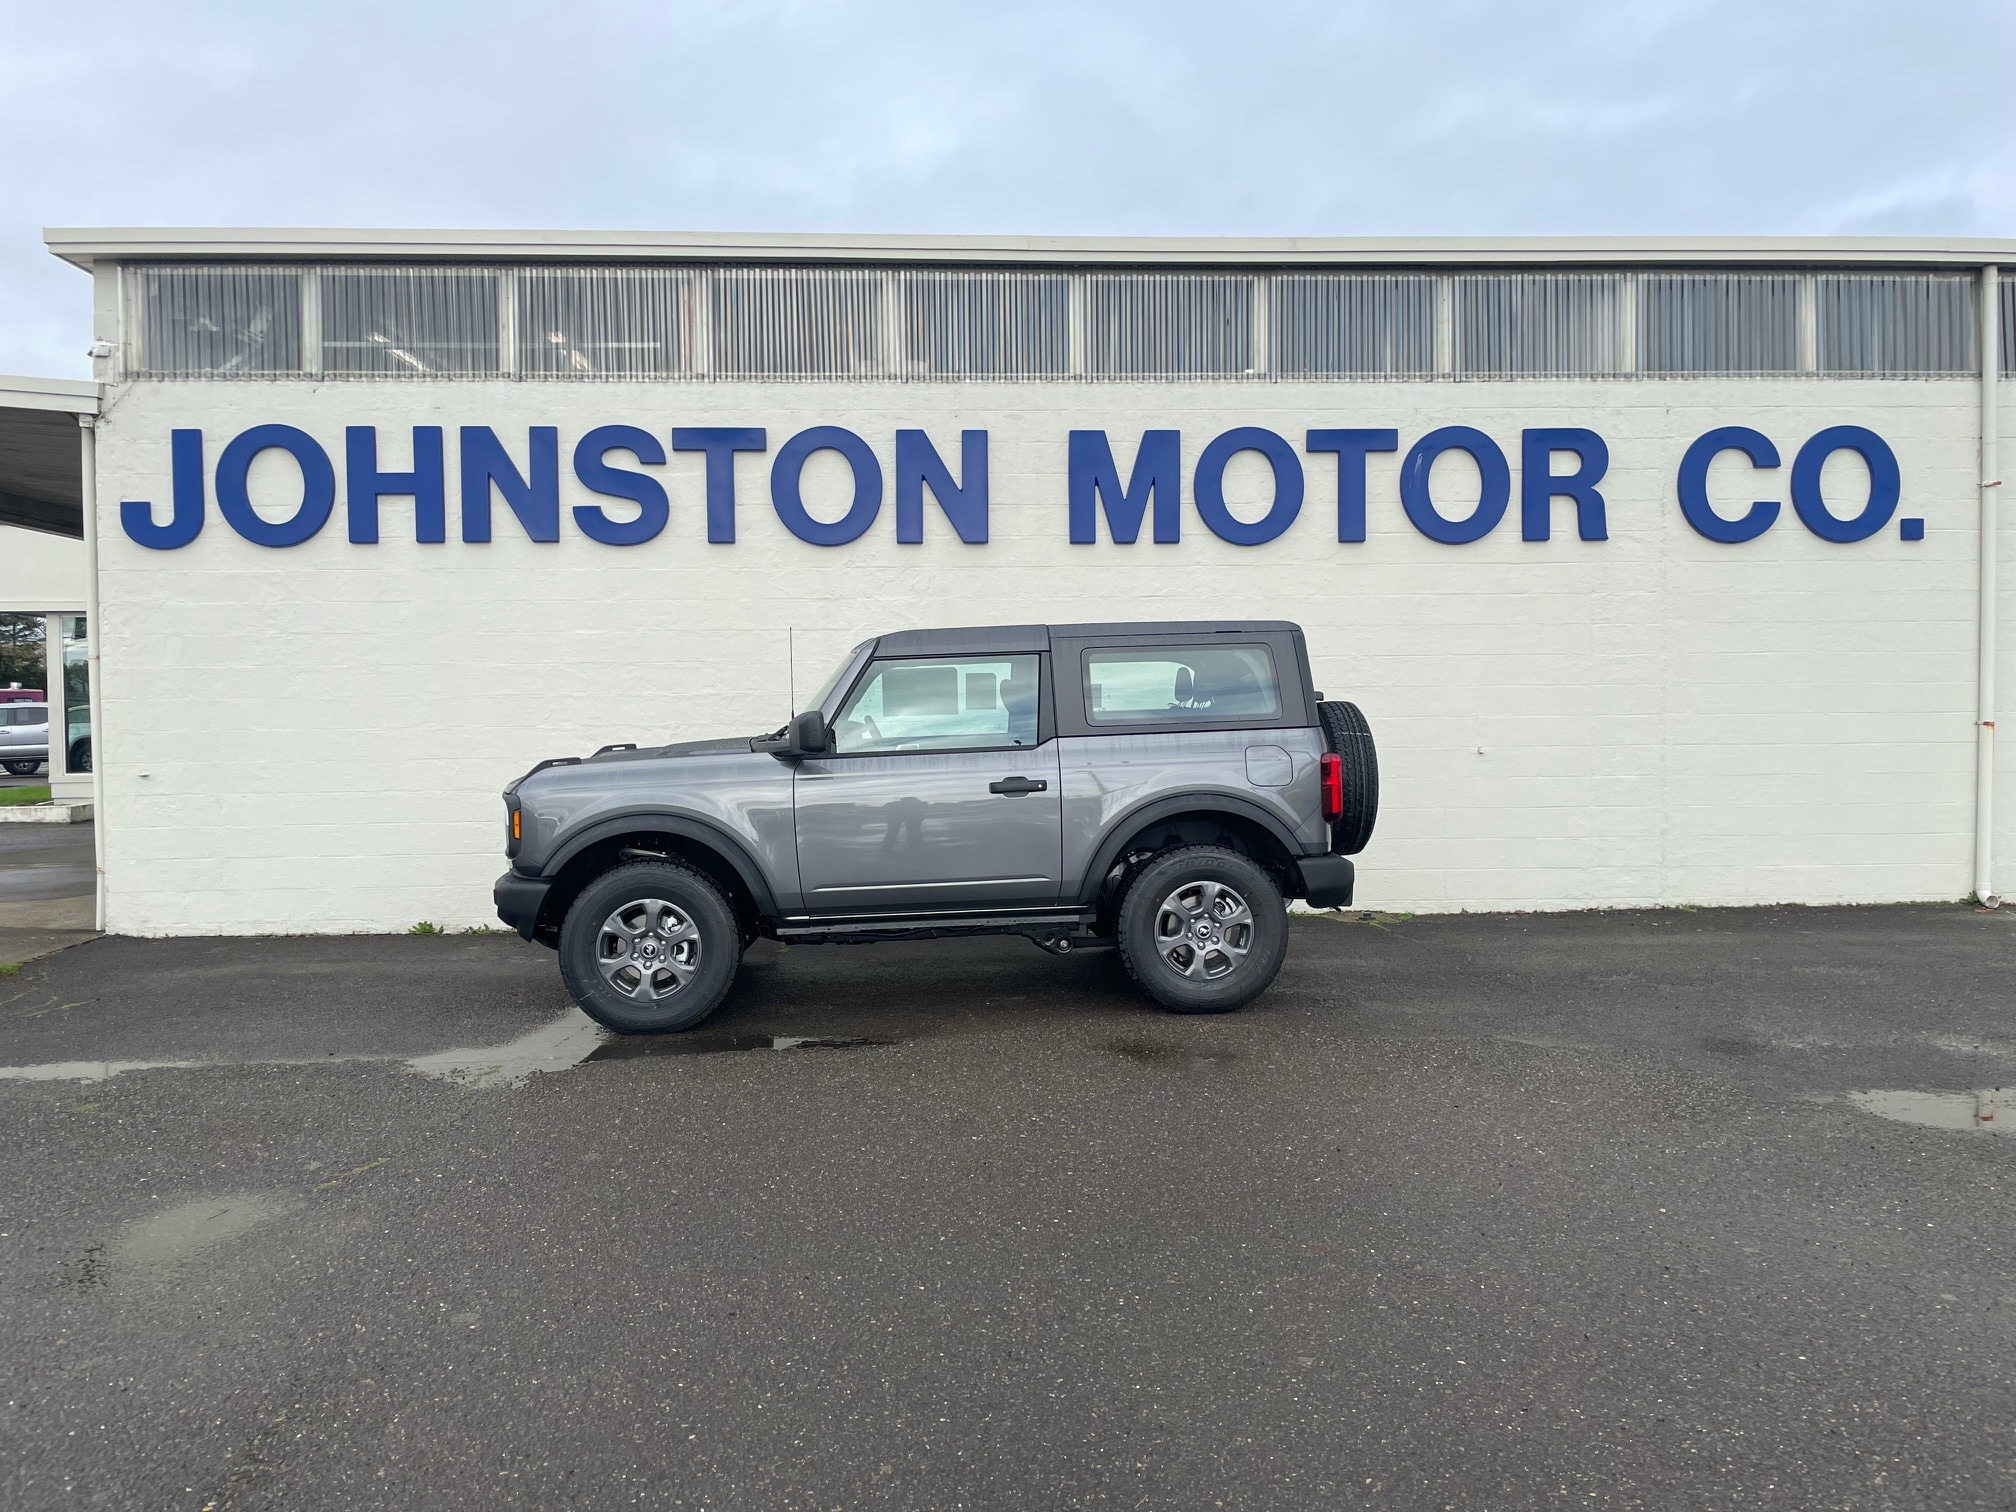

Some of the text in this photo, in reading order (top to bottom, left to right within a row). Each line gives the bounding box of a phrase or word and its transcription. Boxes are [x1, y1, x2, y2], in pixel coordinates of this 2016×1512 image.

[121, 424, 1923, 549] JOHNSTON MOTOR CO.
